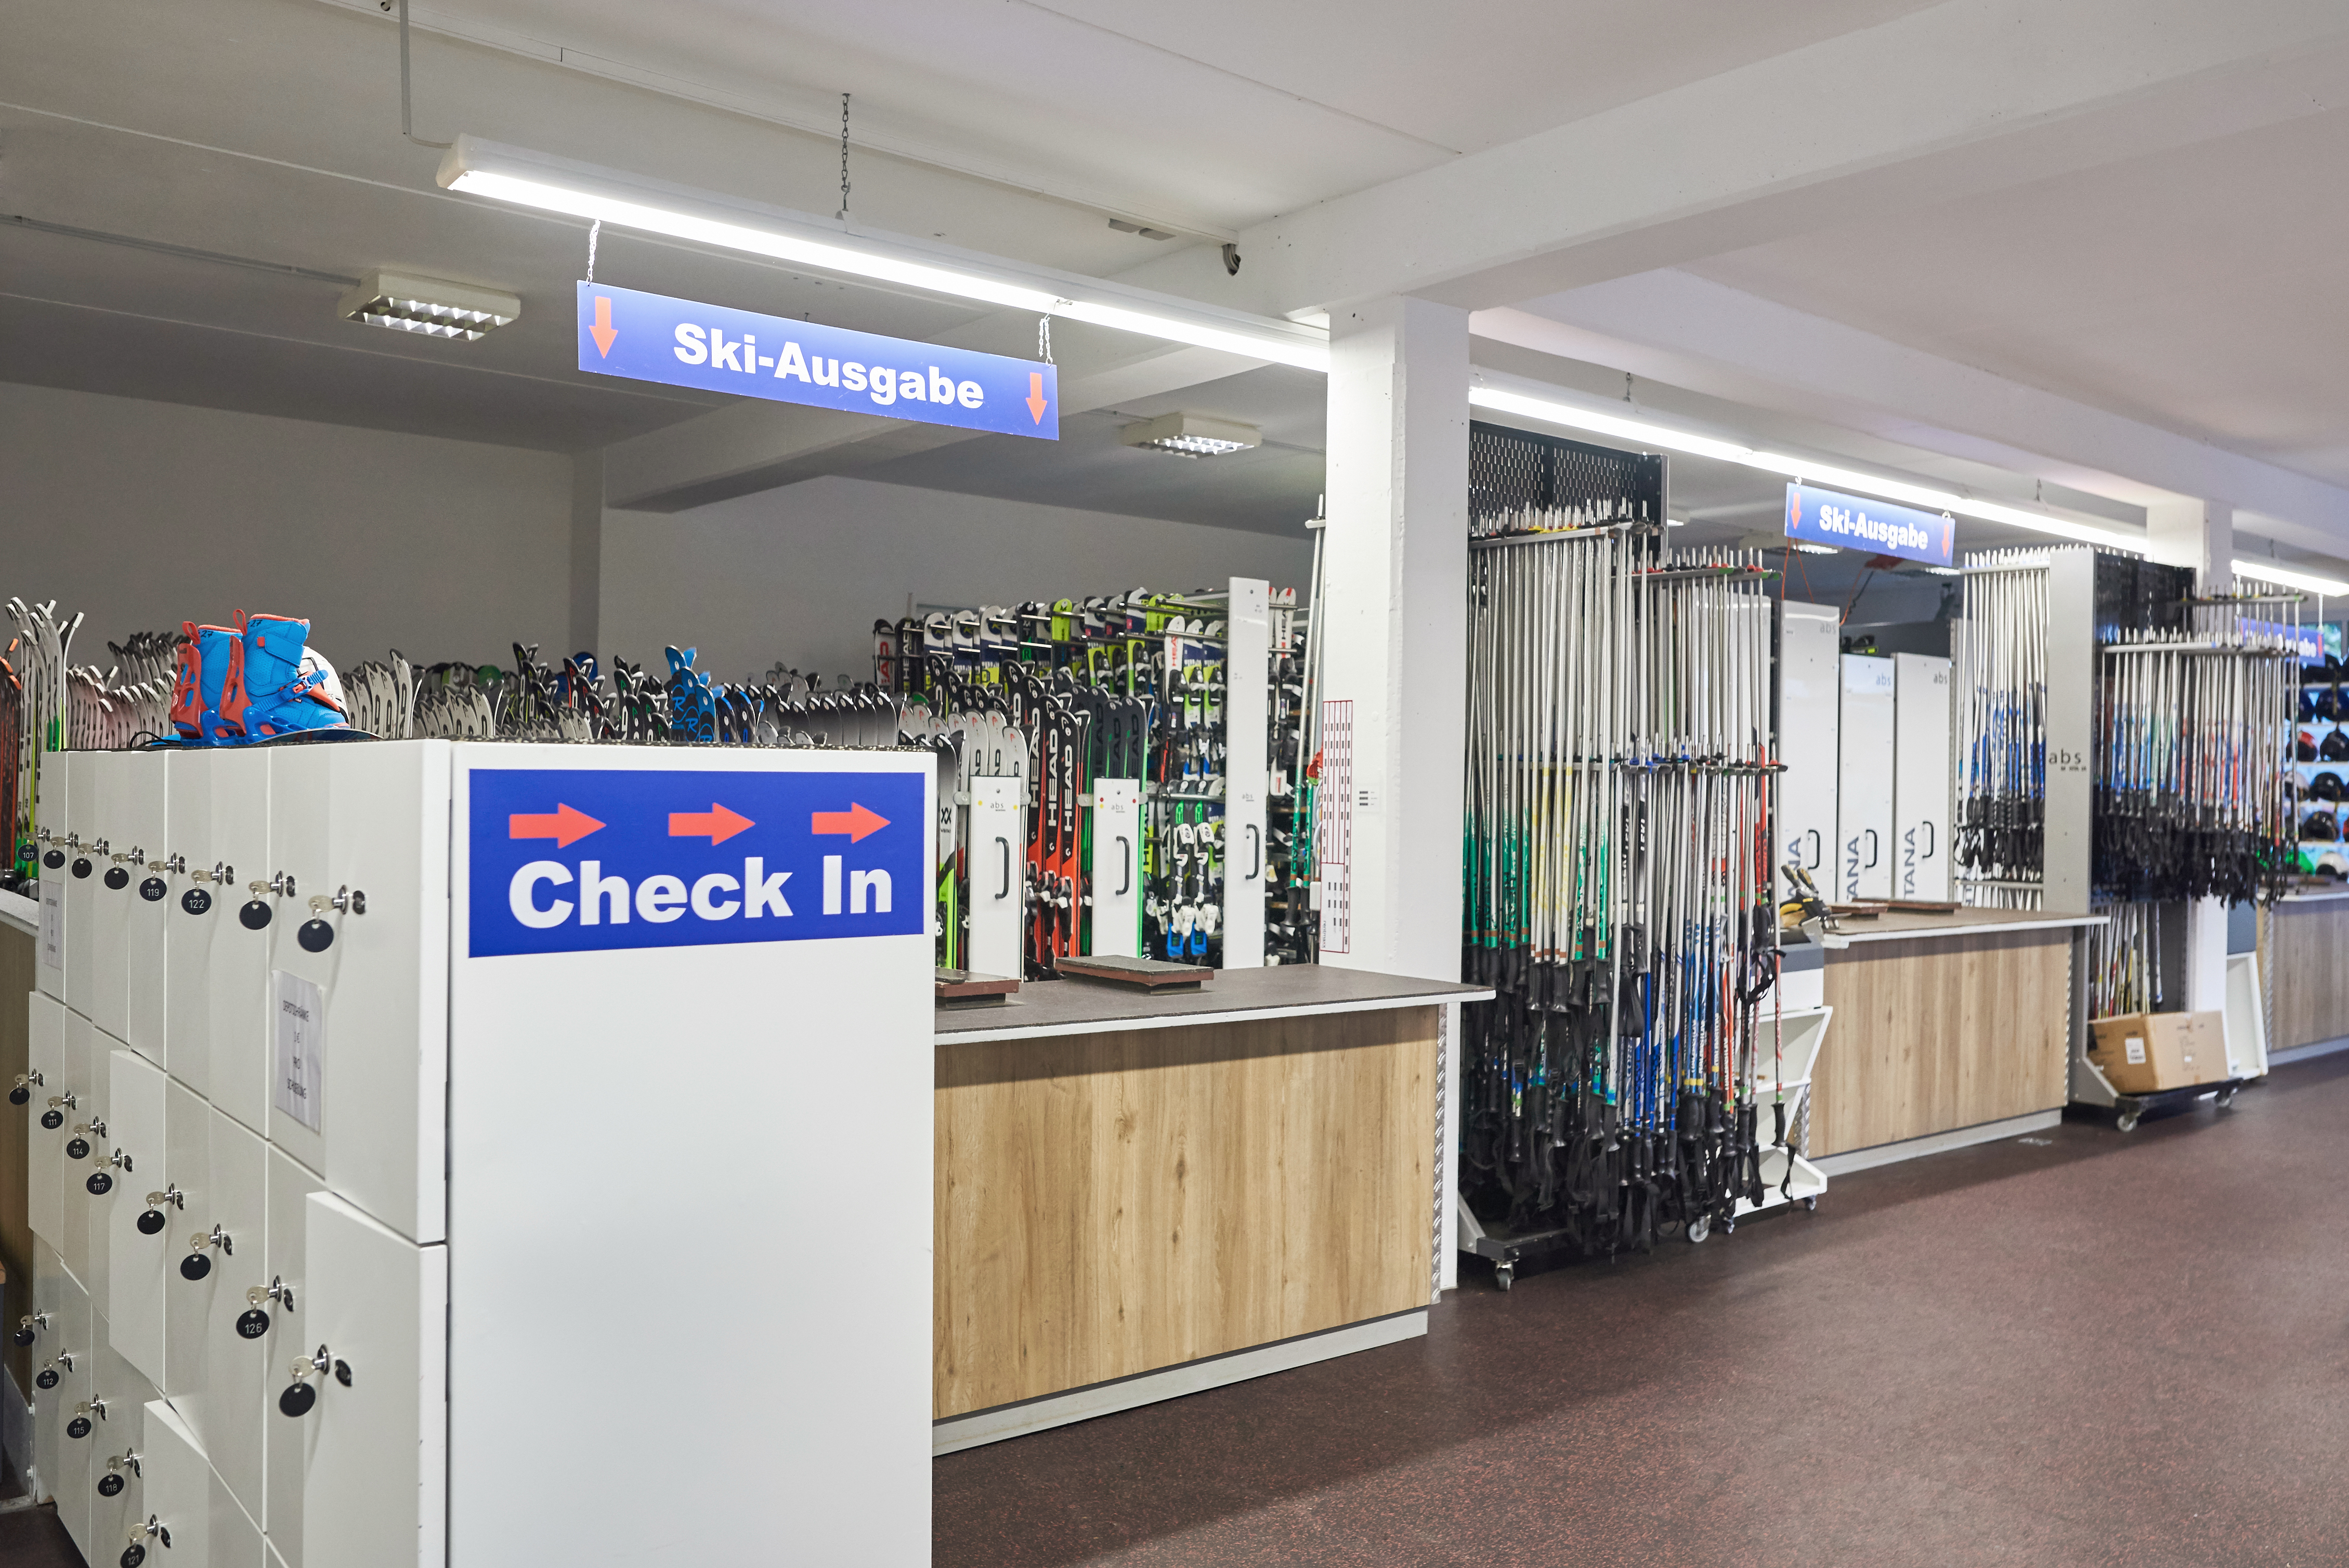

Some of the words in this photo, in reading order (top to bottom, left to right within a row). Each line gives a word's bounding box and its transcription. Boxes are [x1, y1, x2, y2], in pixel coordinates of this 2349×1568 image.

[673, 322, 984, 409] Ski-Ausgabe
[1819, 504, 1928, 550] Ski-Ausgabe
[1876, 672, 1891, 687] abs
[1933, 670, 1948, 685] abs
[2048, 748, 2081, 765] abs
[1048, 728, 1058, 827] HEAD
[1064, 744, 1073, 832] HEAD
[147, 888, 159, 896] 119
[508, 856, 794, 929] Check
[822, 855, 892, 916] In
[188, 899, 205, 909] 122
[245, 1323, 262, 1334] 126
[105, 1484, 118, 1493] 118
[128, 1554, 139, 1565] 121
